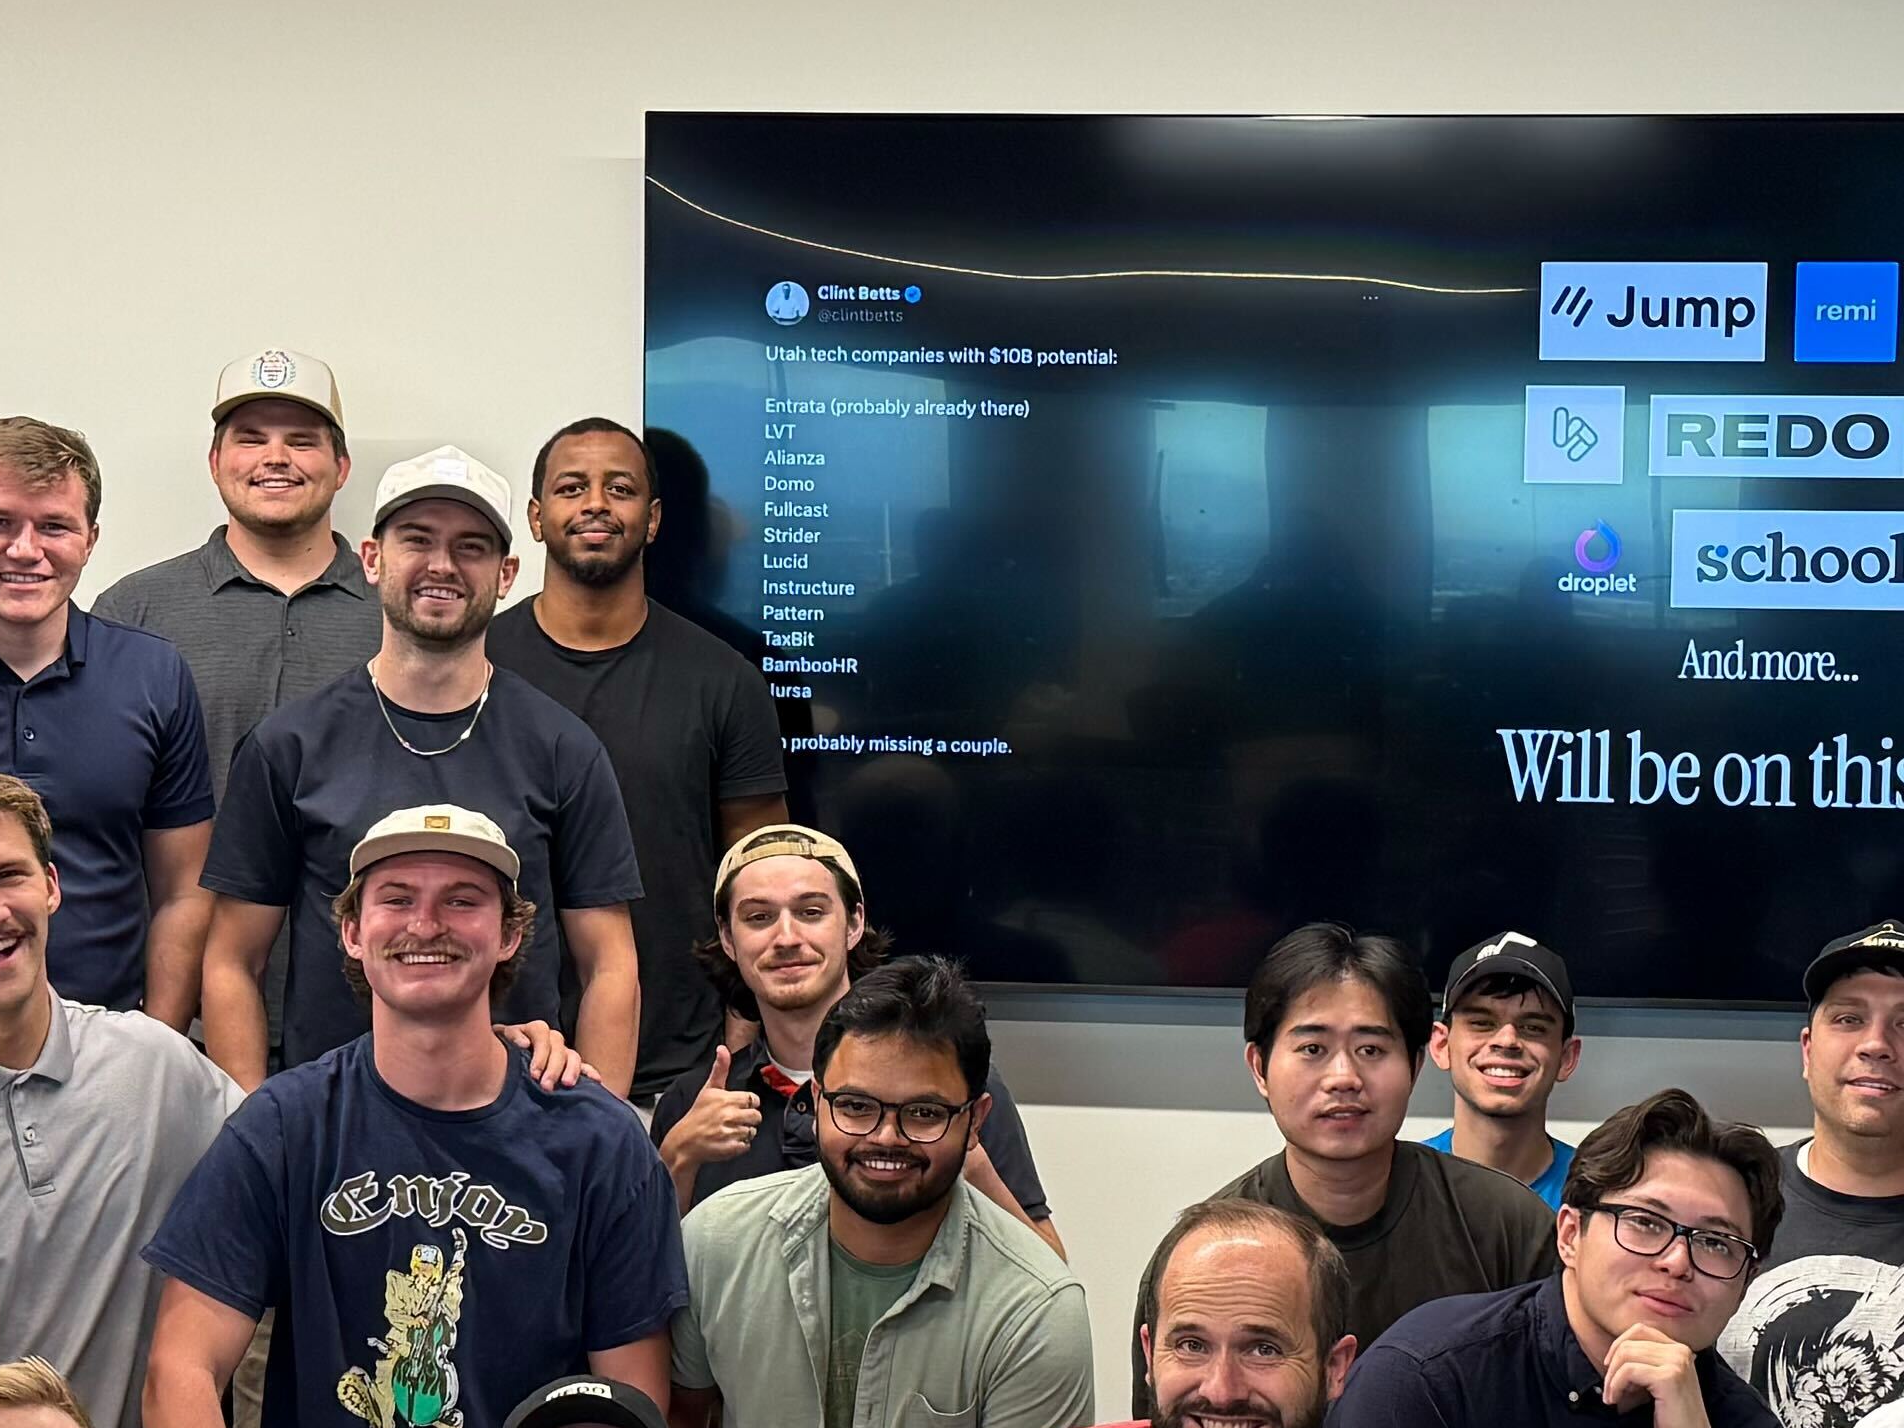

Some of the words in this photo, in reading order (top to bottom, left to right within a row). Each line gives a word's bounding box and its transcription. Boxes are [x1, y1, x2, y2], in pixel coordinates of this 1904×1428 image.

[817, 285, 855, 301] Clint
[858, 285, 901, 301] Betts
[818, 308, 904, 324] @clintbetts
[1607, 285, 1756, 338] Jump
[1815, 299, 1877, 322] remi
[765, 345, 806, 362] Utah
[811, 346, 847, 362] tech
[851, 346, 945, 366] companies
[948, 347, 985, 364] with
[989, 346, 1033, 365] $10B
[1037, 348, 1118, 367] potential:
[765, 398, 826, 415] Entrata
[830, 398, 910, 418] (probably
[914, 399, 976, 419] already
[980, 399, 1031, 419] there)
[764, 424, 796, 440] LVT
[1666, 413, 1890, 461] REDO
[764, 450, 825, 466] Alianza
[764, 476, 815, 492] Domo
[764, 502, 829, 518] Fullcast
[763, 528, 821, 544] Strider
[763, 553, 808, 570] Lucid
[763, 579, 856, 596] Instructure
[1557, 572, 1637, 596] droplet
[763, 605, 825, 621] Pattern
[762, 630, 815, 648] TaxBit
[762, 656, 858, 674] BambooHR
[1678, 638, 1746, 681] And
[1748, 650, 1859, 682] more...
[790, 734, 865, 754] probably
[869, 735, 933, 756] missing
[936, 740, 946, 752] a
[950, 737, 1013, 756] couple.
[1497, 728, 1614, 803] Will
[1627, 730, 1701, 805] be
[1714, 752, 1796, 808] on
[320, 1170, 548, 1250] Enjoy
